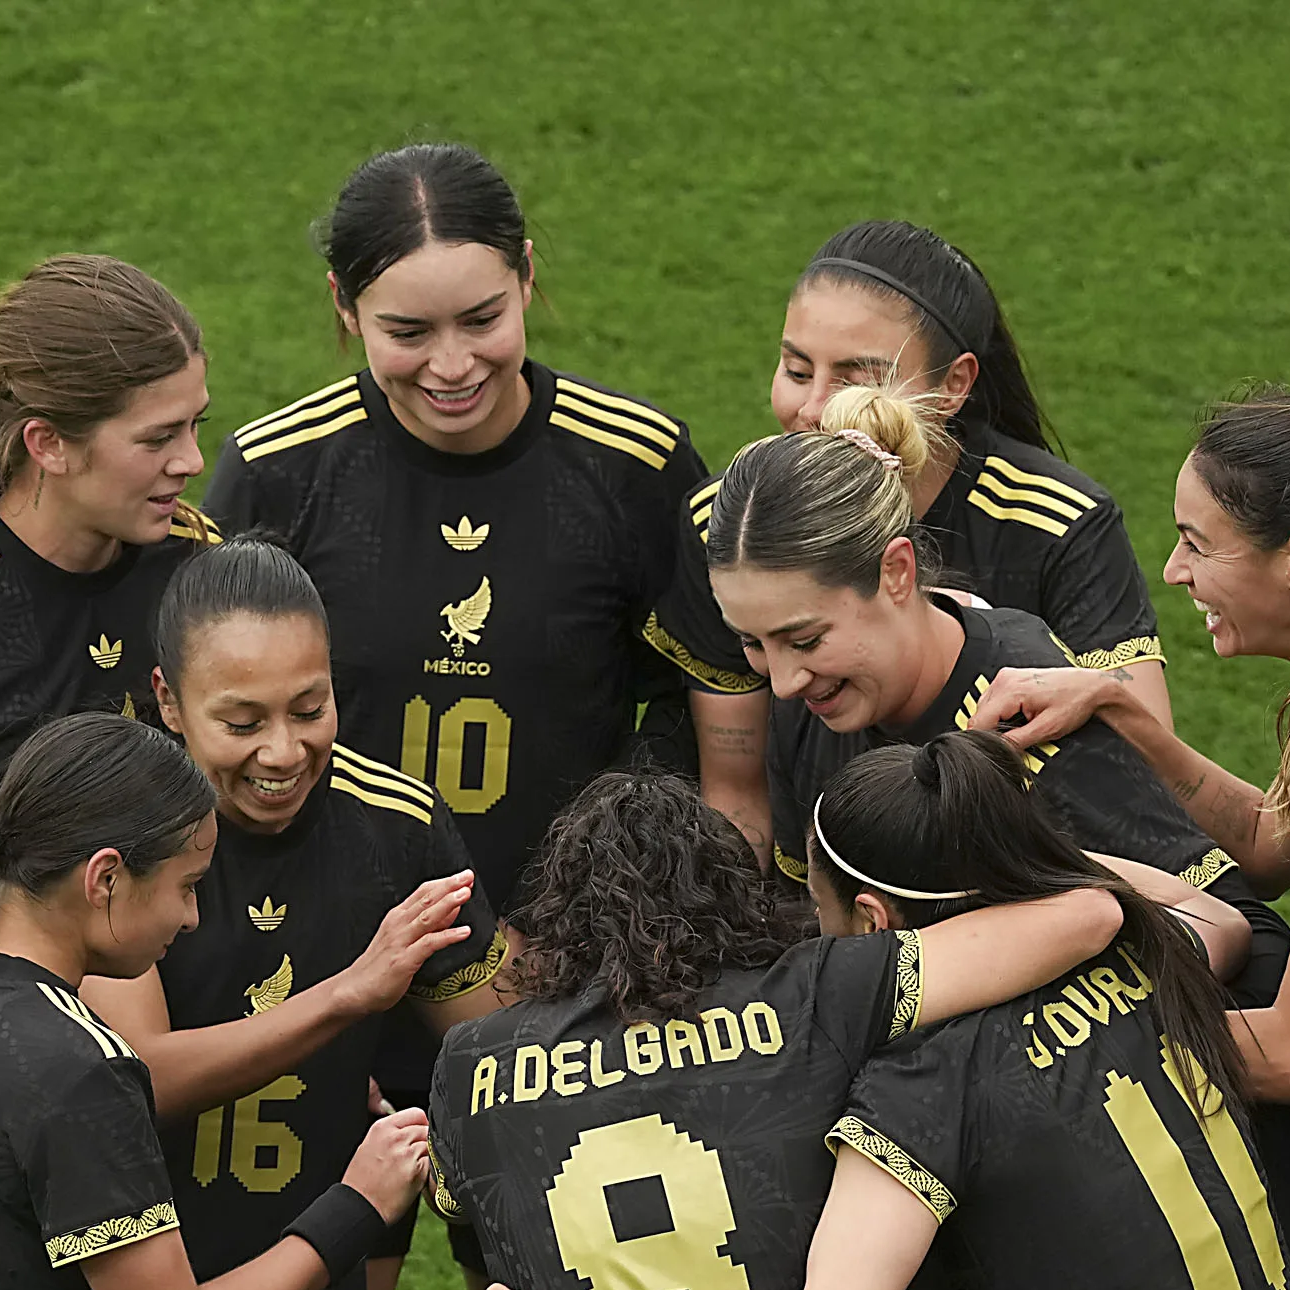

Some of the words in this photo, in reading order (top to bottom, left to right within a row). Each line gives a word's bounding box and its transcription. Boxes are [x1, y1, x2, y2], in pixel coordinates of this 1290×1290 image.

[422, 657, 492, 677] MÉXICO
[400, 695, 512, 814] 10
[470, 1001, 785, 1116] A.DELGADO
[192, 1075, 308, 1193] 16
